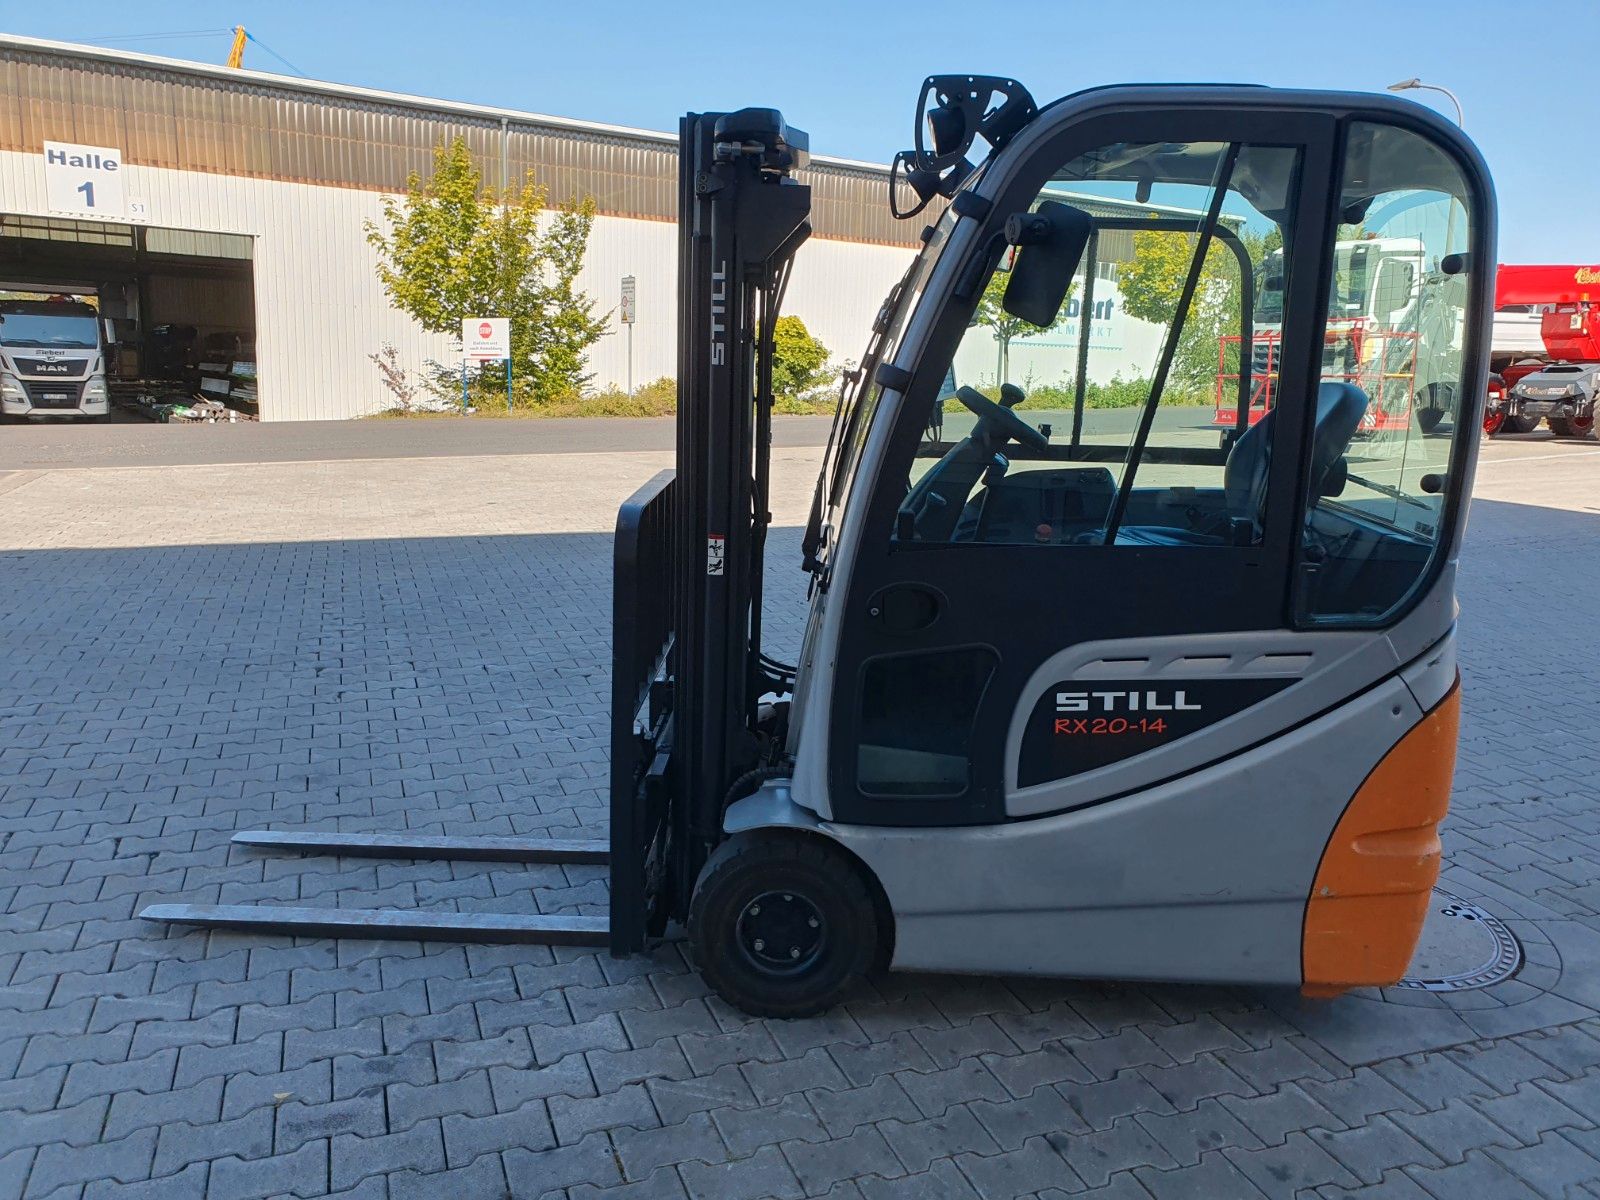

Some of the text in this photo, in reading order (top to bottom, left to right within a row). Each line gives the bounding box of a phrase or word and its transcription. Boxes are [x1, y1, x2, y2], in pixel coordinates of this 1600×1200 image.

[47, 149, 119, 171] Halle
[77, 181, 95, 207] 1
[711, 260, 726, 366] STILL
[1056, 690, 1202, 712] STILL
[1055, 718, 1168, 734] RX20-14
